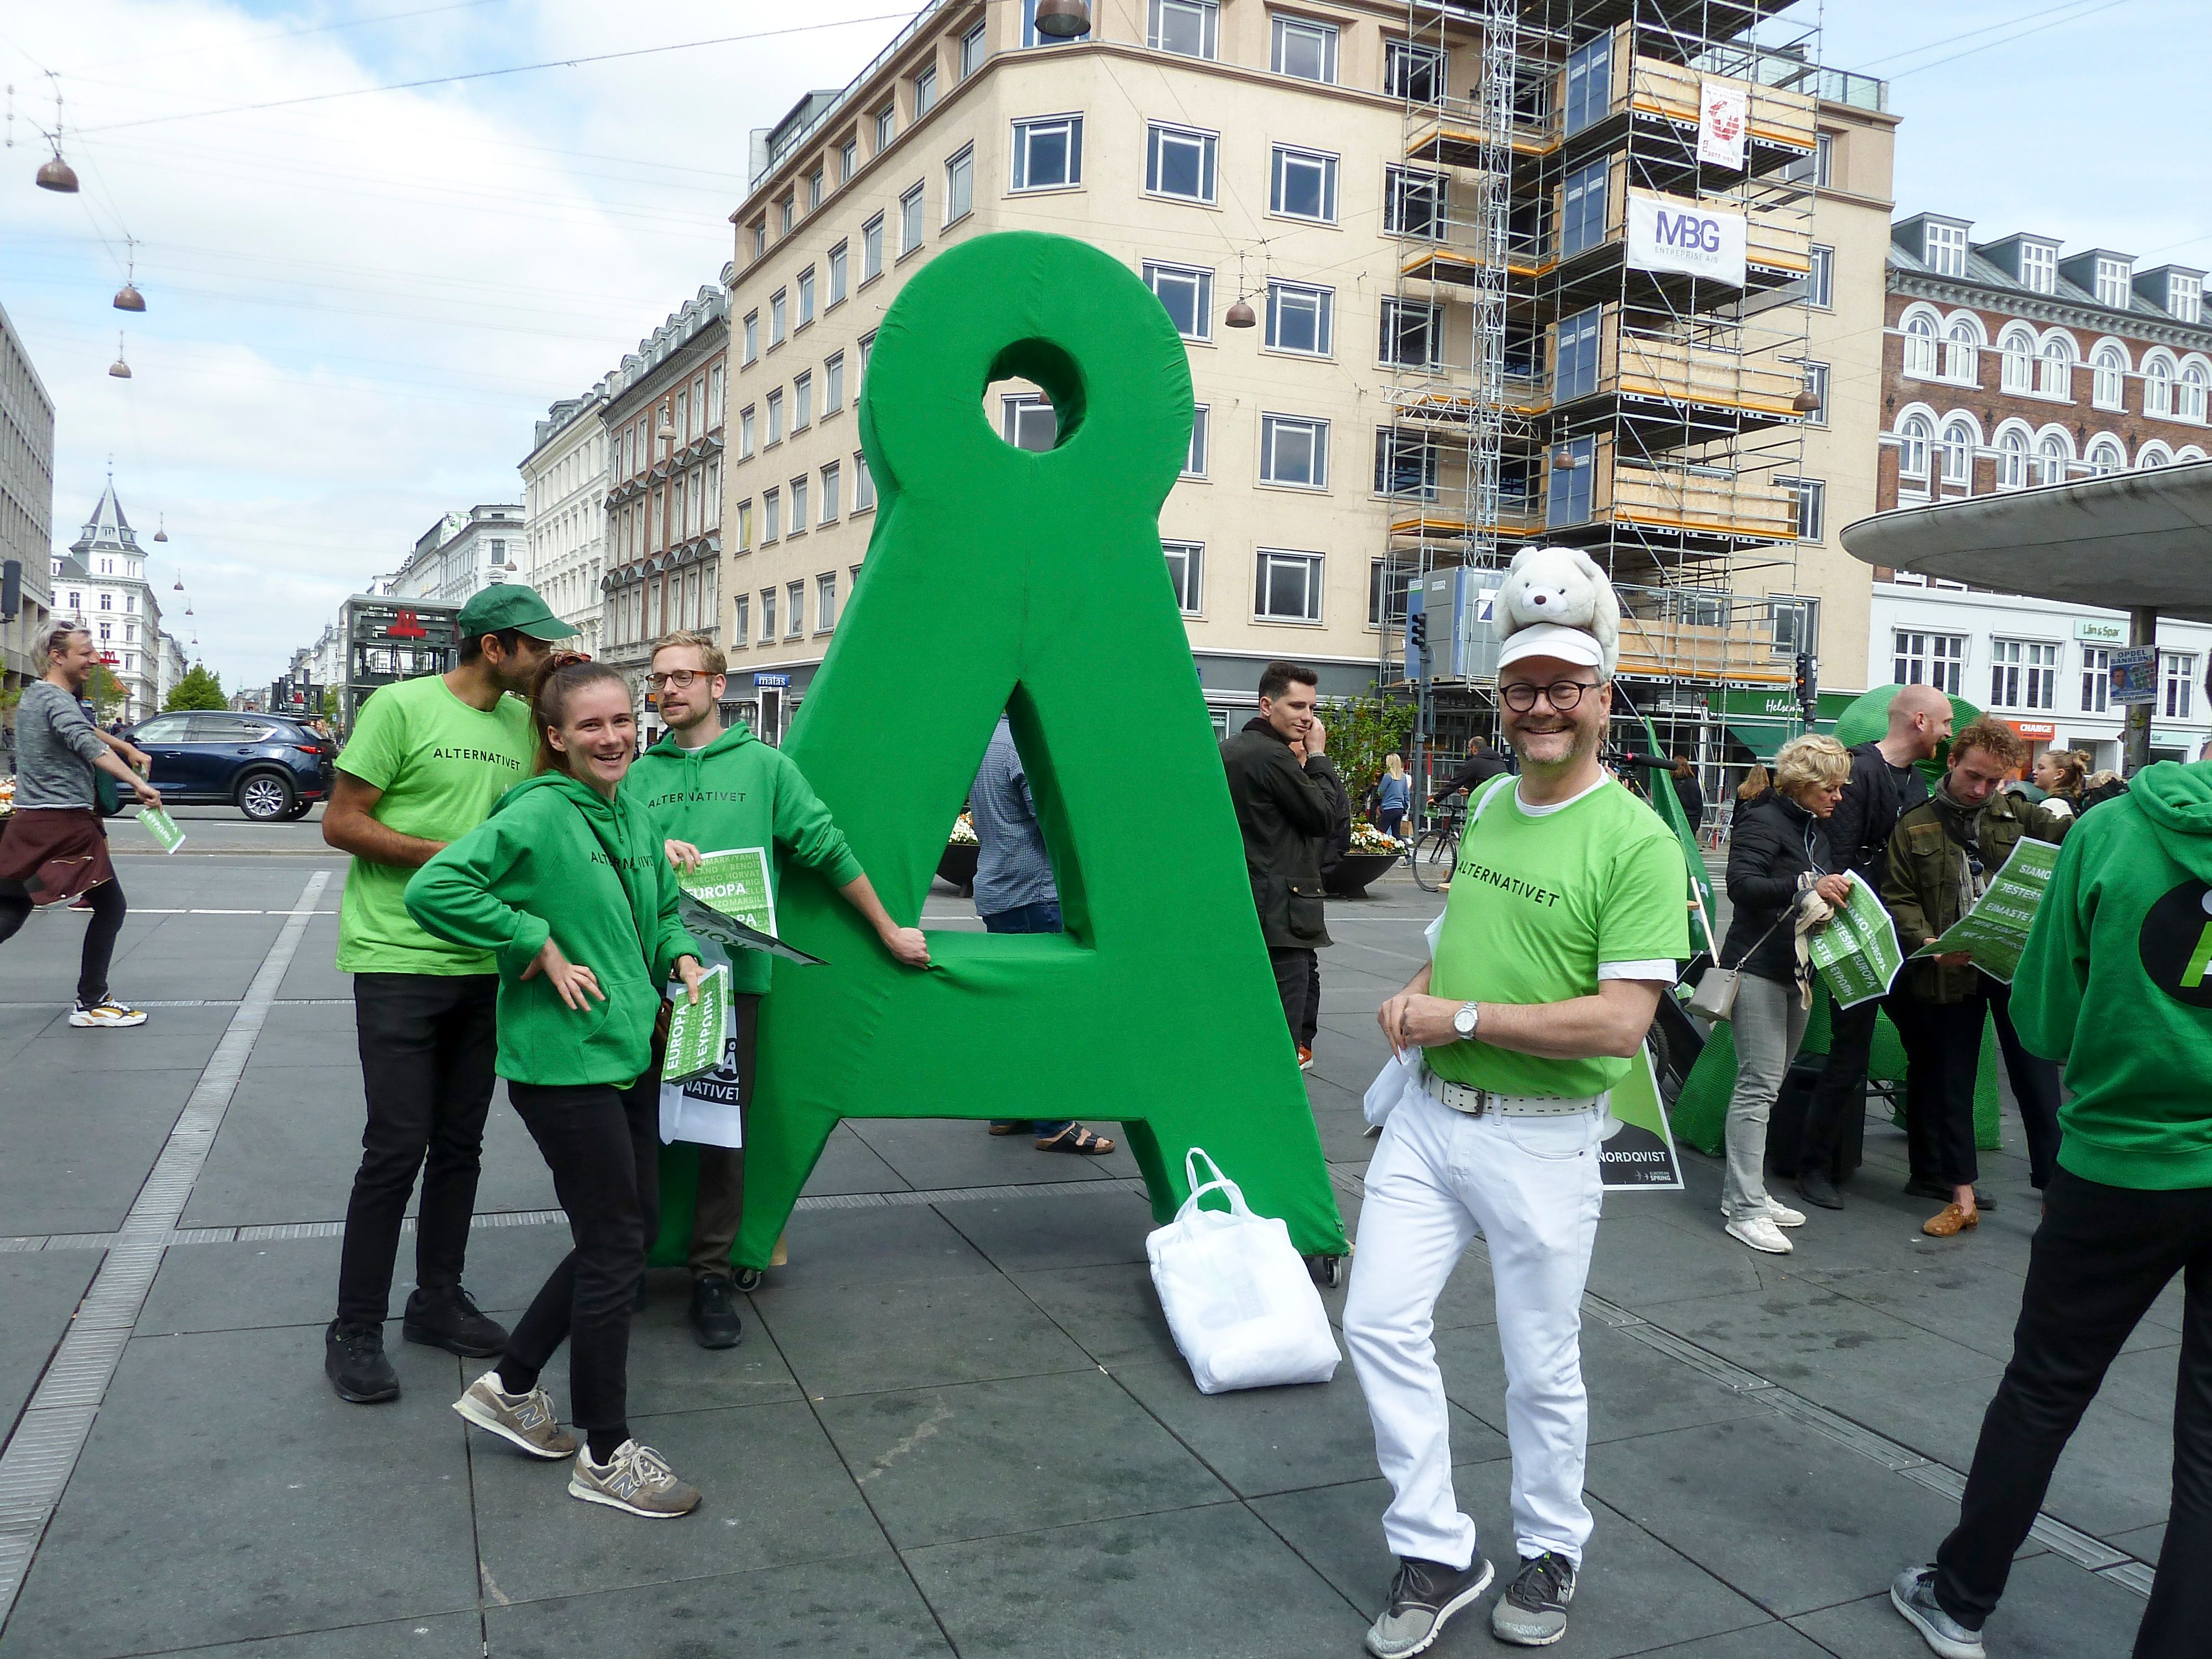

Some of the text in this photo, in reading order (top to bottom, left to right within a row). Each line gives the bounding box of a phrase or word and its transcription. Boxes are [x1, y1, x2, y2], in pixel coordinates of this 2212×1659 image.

[1656, 211, 1719, 253] MBG
[1655, 246, 1718, 264] ENTREPRISE A/S
[2103, 626, 2121, 638] Spar
[2111, 655, 2153, 664] BANKERNE
[2117, 649, 2146, 658] OPDEL
[758, 676, 785, 686] matas
[2020, 724, 2053, 733] CHANGE
[433, 748, 520, 771] ALTERNATIVET
[648, 792, 747, 808] ALTERNATIVET
[2019, 864, 2052, 880] SIAMO
[1457, 860, 1561, 907] ALTERNATIVET
[1830, 915, 1860, 953] ESTEŚMY
[684, 1081, 739, 1101] NATIVET
[1598, 1151, 1666, 1163] NORDQVIST
[515, 1404, 546, 1431] N
